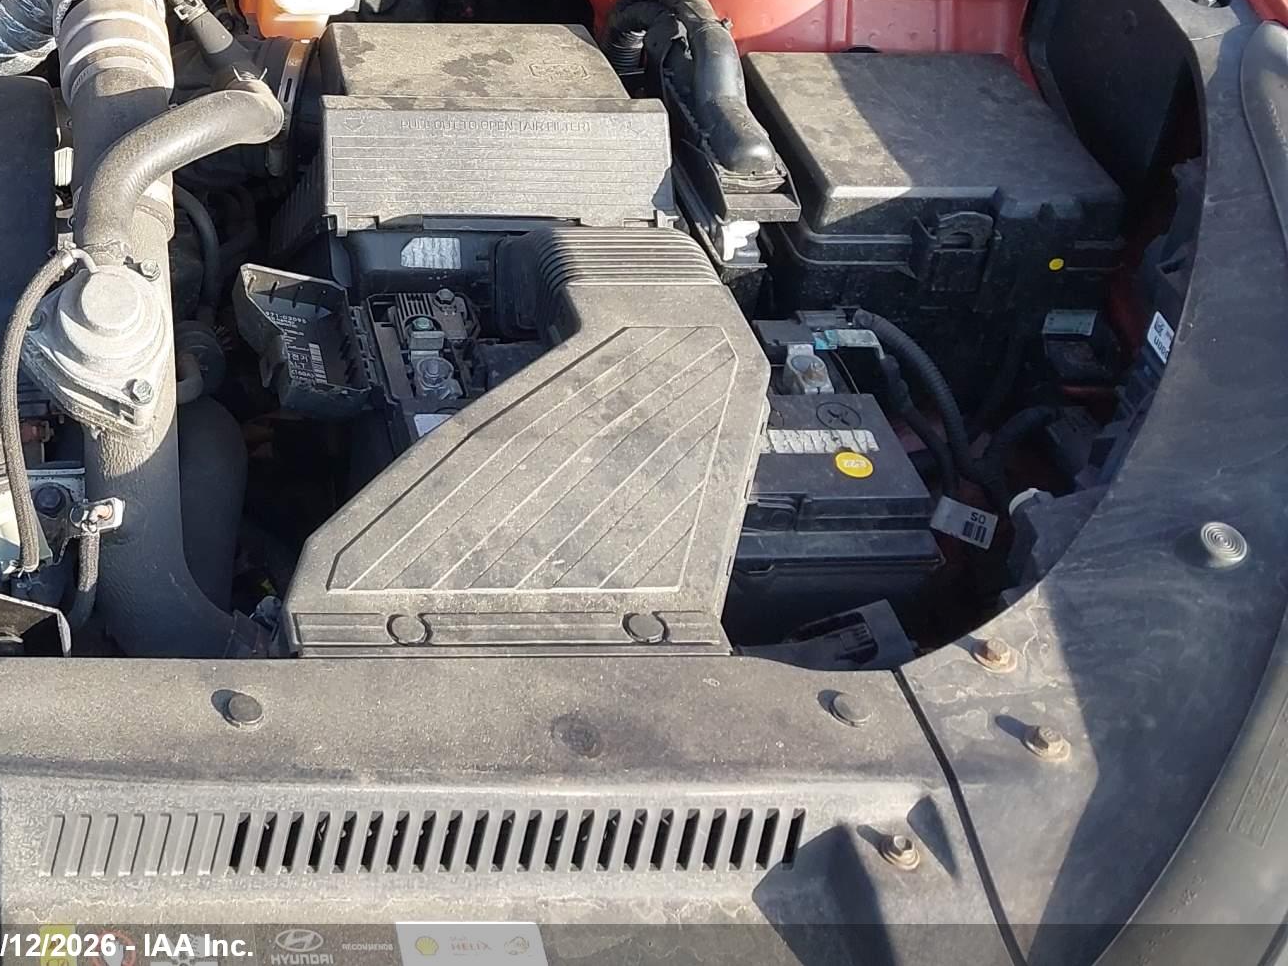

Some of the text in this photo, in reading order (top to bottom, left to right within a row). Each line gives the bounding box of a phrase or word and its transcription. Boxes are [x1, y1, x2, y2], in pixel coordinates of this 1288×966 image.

[480, 119, 513, 132] OPEN
[342, 943, 393, 951] RECOMMENDS
[271, 953, 334, 965] HYUNDAI
